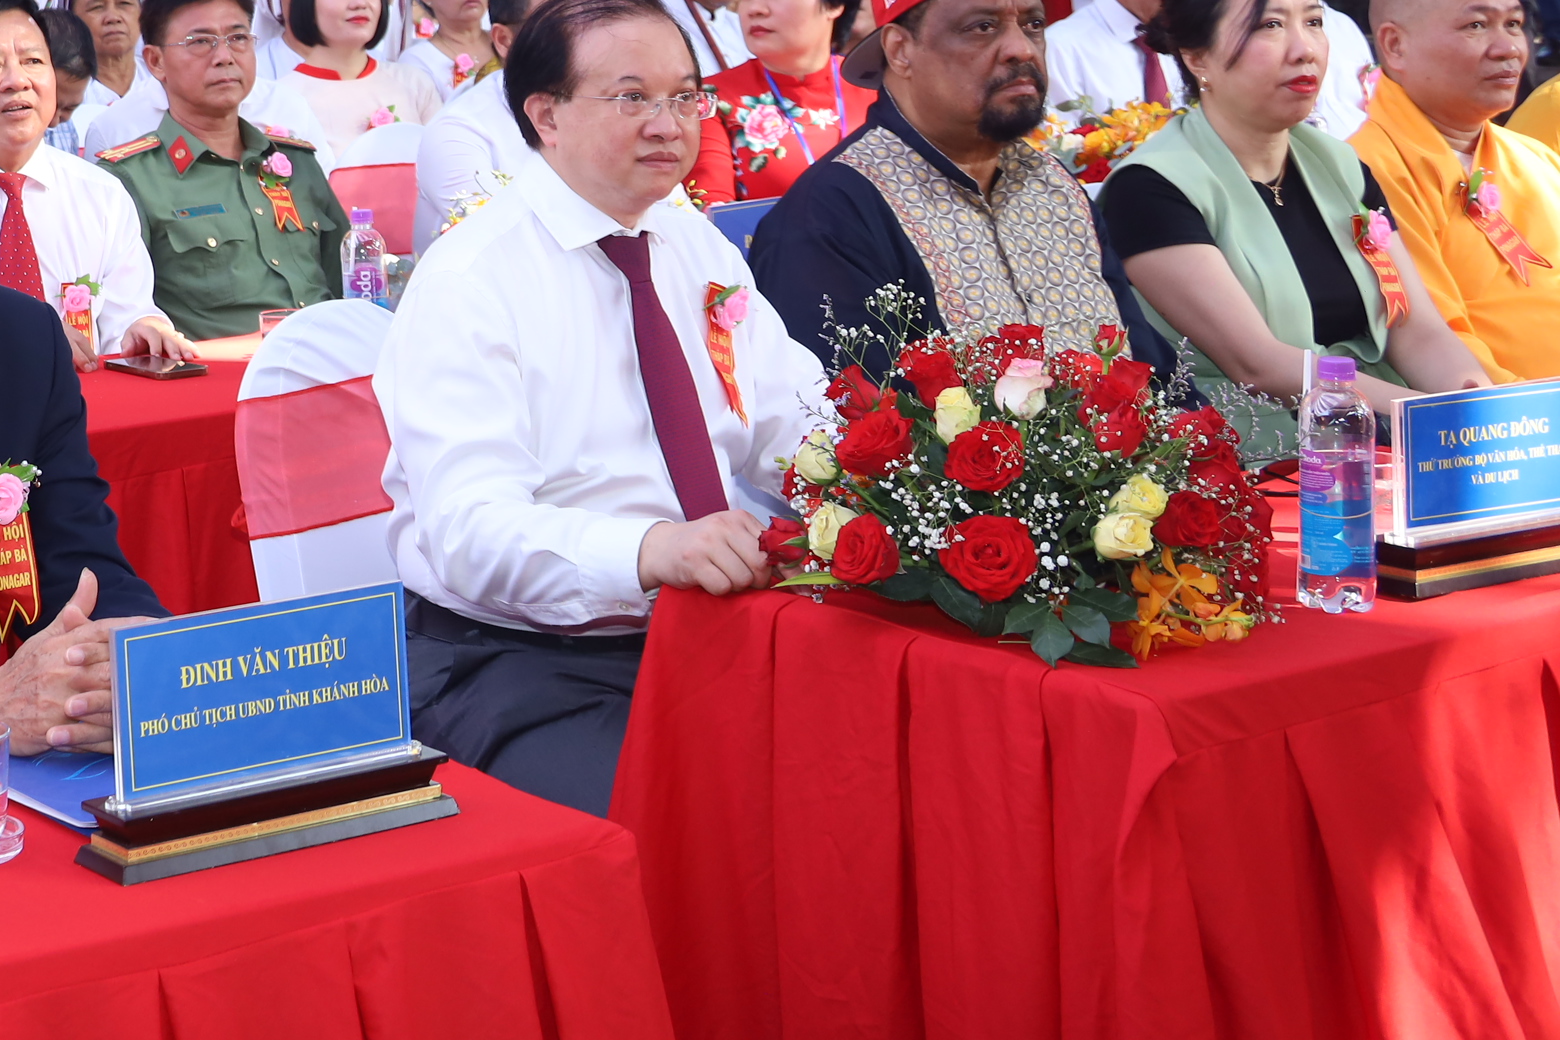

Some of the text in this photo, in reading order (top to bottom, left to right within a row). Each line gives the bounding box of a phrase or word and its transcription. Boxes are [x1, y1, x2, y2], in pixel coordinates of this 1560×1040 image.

[1438, 416, 1549, 449] TẠ QUANG ĐÔNG
[1471, 469, 1520, 486] VÀ DU LỊCH
[2, 521, 25, 542] HỘI
[14, 545, 28, 563] BÀ
[180, 633, 347, 689] ĐINH VĂN THIỆU
[140, 673, 390, 738] PHÓ CHỦ TỊCH UBND TỈNH KHÁNH HÒA
